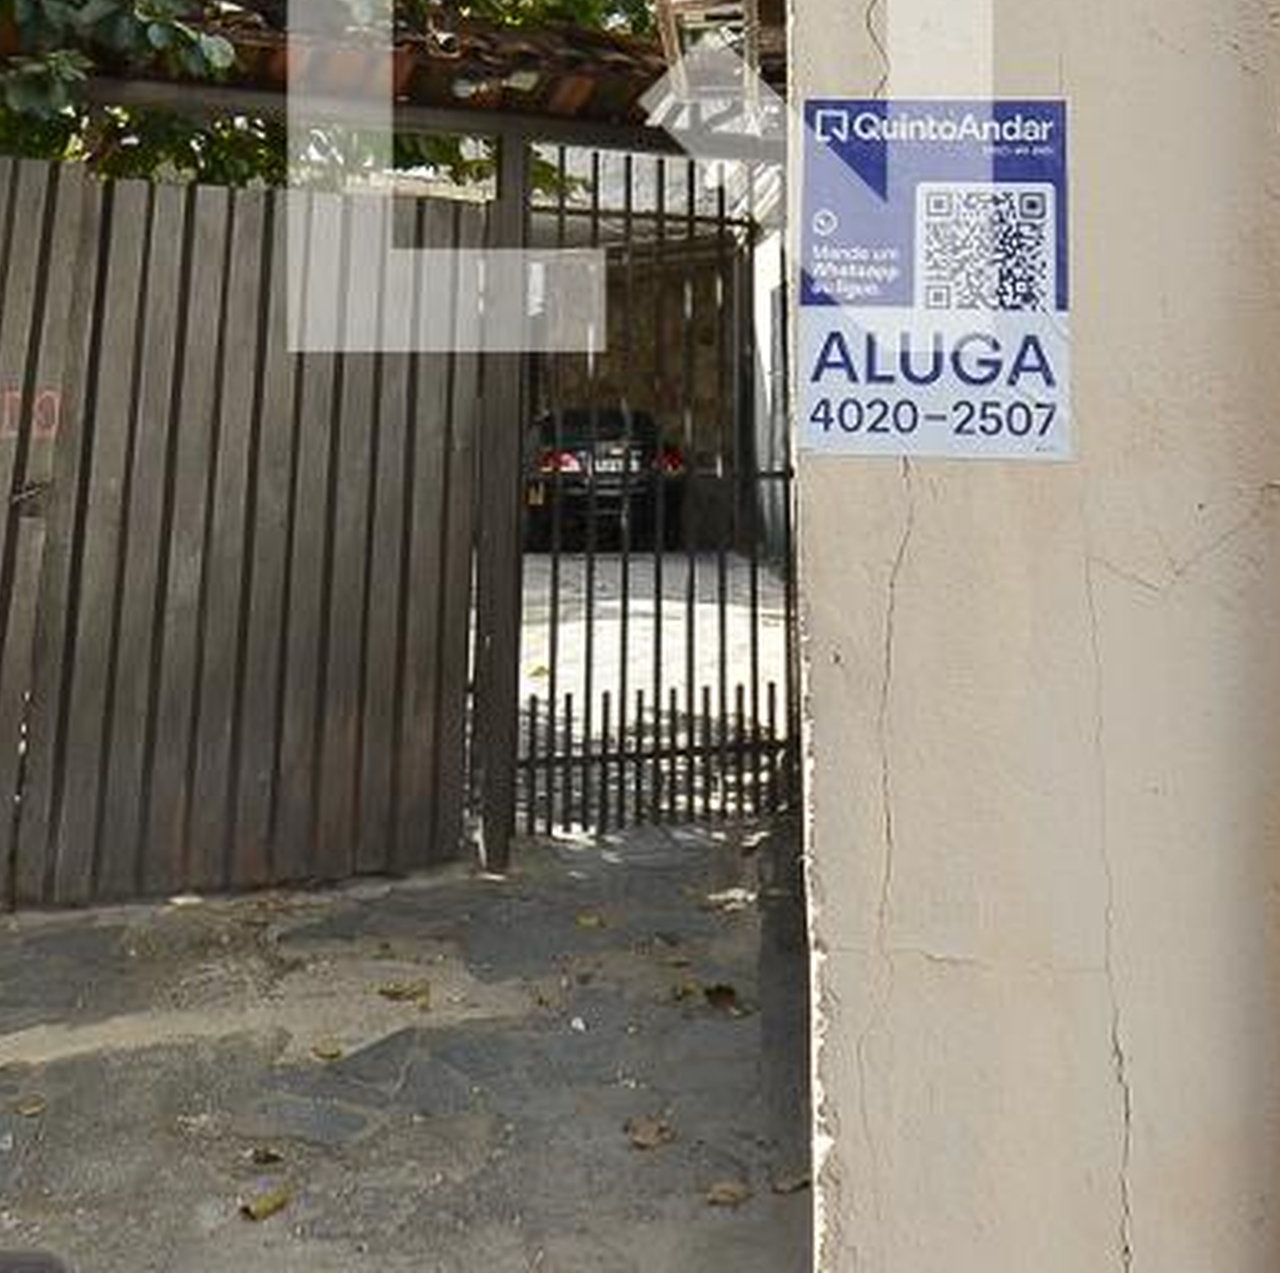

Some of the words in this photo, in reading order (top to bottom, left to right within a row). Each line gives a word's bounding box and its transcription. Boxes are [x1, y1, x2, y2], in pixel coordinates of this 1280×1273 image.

[853, 112, 1054, 142] QuintoAndar
[812, 244, 869, 260] Mande
[810, 330, 1057, 388] ALUGA
[809, 397, 1058, 436] 4020-2507
